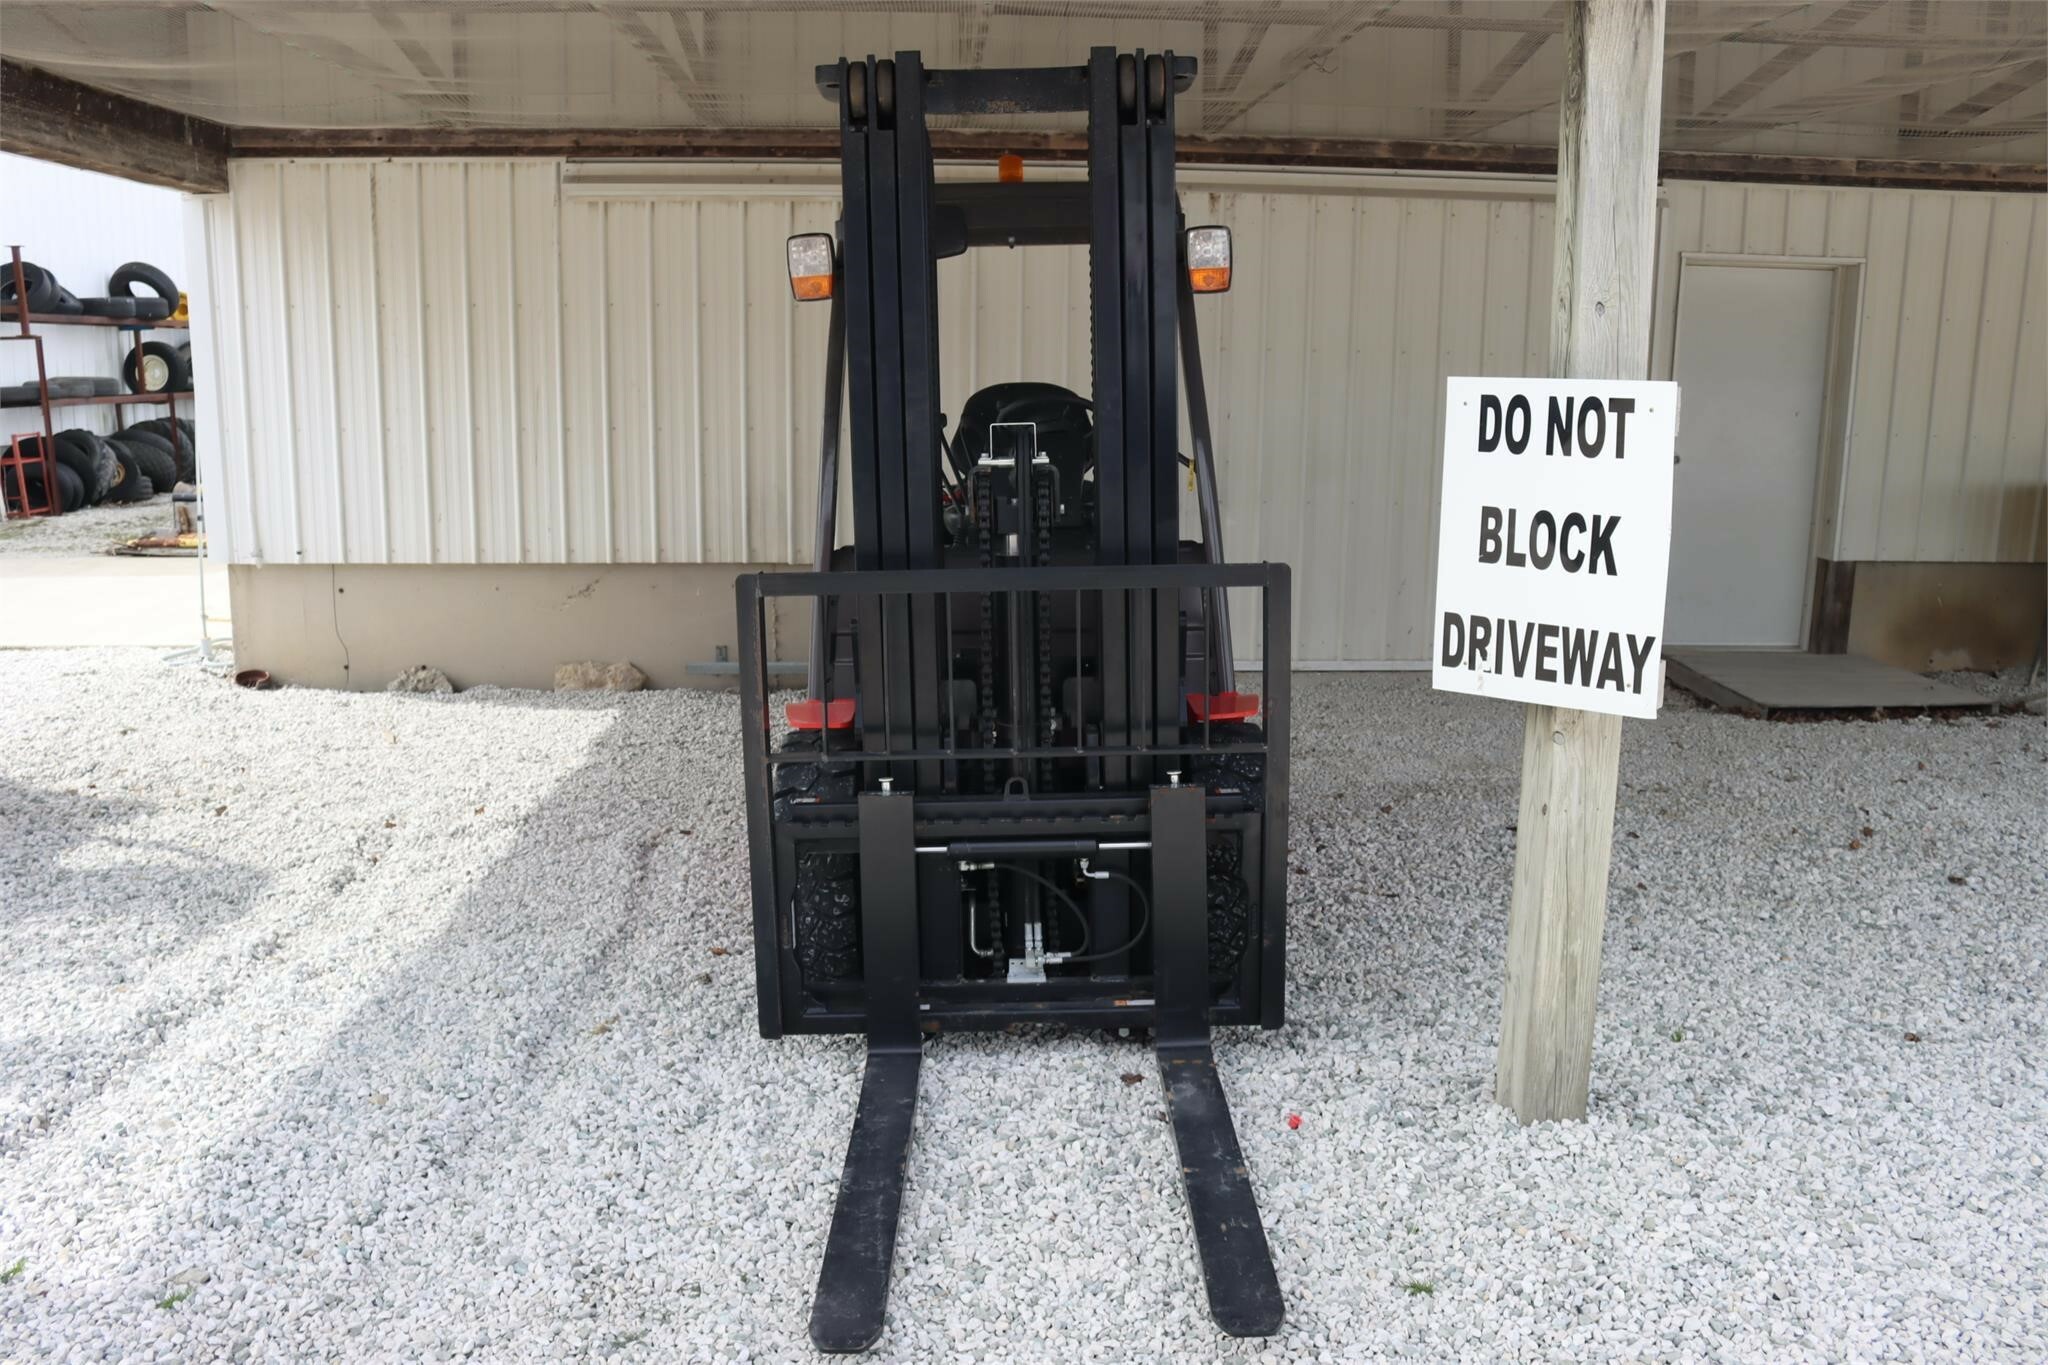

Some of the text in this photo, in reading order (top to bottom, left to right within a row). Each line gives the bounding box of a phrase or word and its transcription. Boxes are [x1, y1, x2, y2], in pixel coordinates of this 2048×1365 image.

[1478, 394, 1635, 459] DO NOT
[1478, 505, 1621, 576] BLOCK
[1441, 612, 1656, 695] DRIVEWAY
